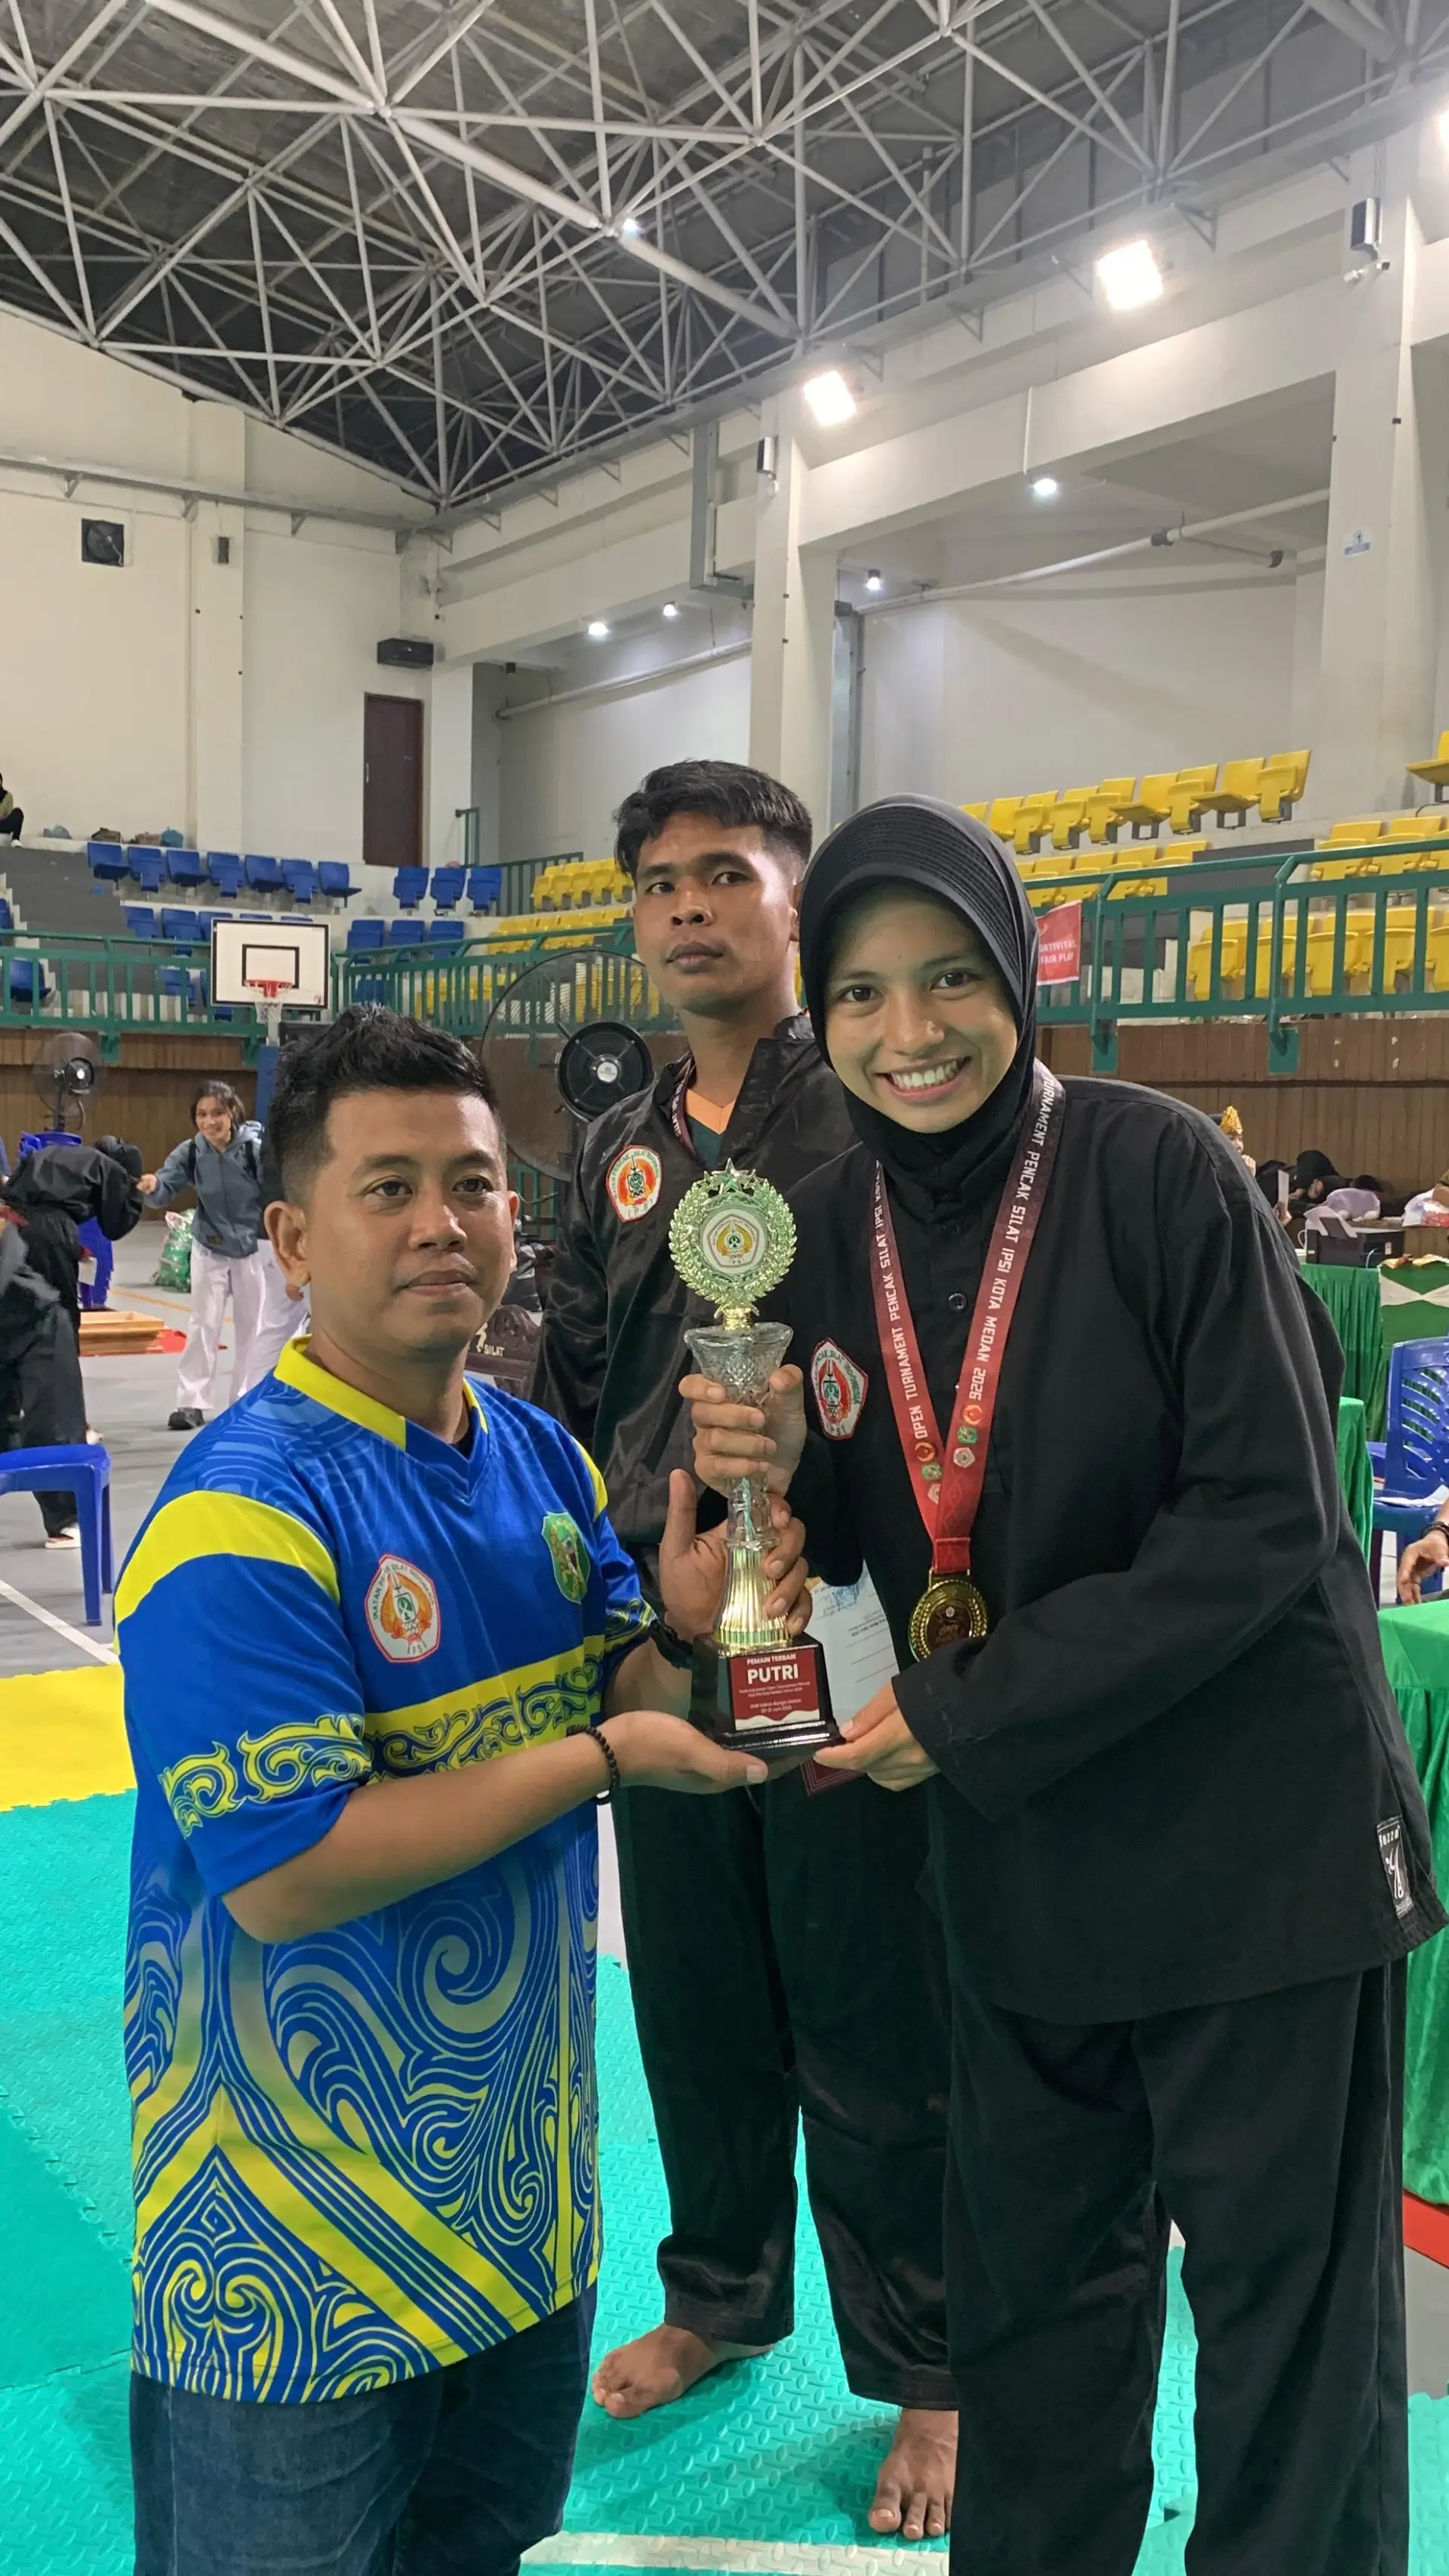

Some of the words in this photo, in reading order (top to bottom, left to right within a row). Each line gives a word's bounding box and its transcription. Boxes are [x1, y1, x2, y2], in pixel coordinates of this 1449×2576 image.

[1016, 1150, 1040, 1200] PENCAK
[874, 1205, 884, 1229] IPSI
[1005, 1205, 1026, 1243] SILAT
[875, 1233, 891, 1268] SILAT
[997, 1248, 1015, 1273] IPSI
[883, 1273, 900, 1322] PENCAK
[988, 1277, 1008, 1310] KOTA
[484, 1344, 505, 1356] SILAT
[977, 1316, 998, 1362] MEDAN
[891, 1327, 918, 1400] TURNAMENT
[969, 1367, 986, 1401] 2026
[909, 1405, 928, 1439] OPEN
[747, 1656, 771, 1666] PEMAIN
[771, 1653, 797, 1663] TERBAIK
[747, 1663, 799, 1685] PUTRI
